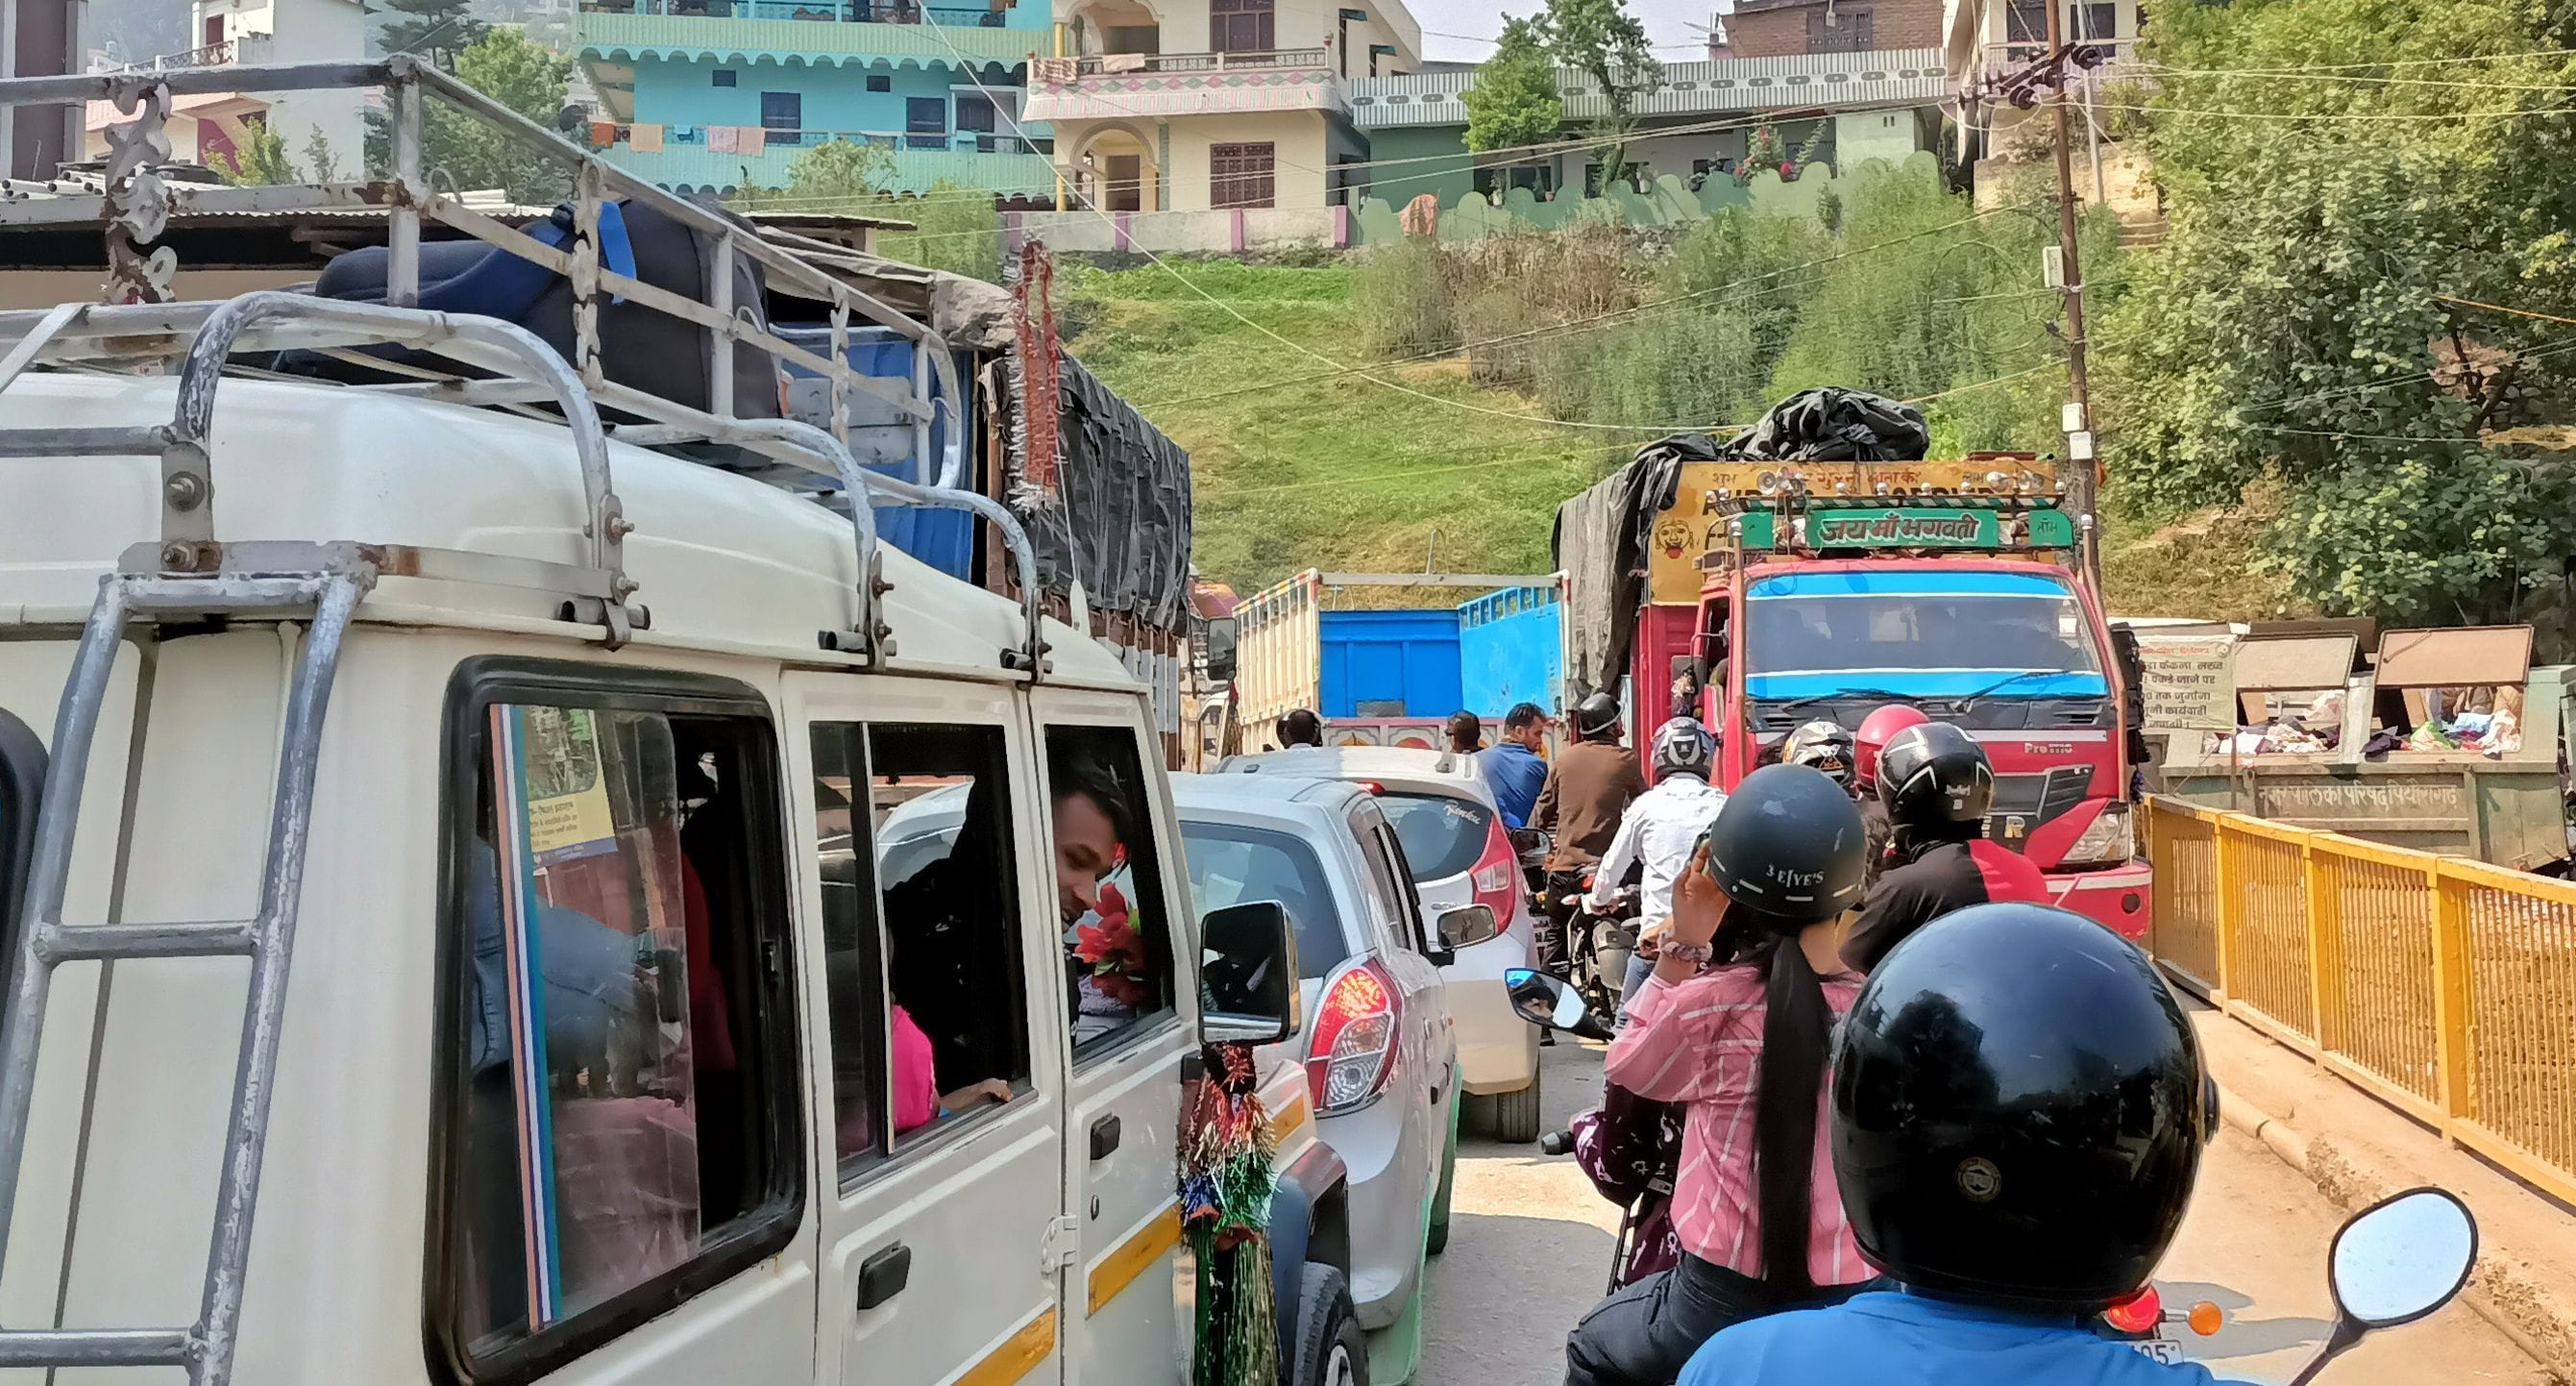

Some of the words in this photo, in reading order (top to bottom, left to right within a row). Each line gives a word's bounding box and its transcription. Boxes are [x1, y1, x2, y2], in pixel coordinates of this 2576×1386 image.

[1821, 517, 1871, 542] जय
[1871, 510, 1902, 540] माँ
[1901, 511, 1980, 541] भगवती
[2024, 742, 2048, 754] Pro
[1766, 864, 1775, 877] 3
